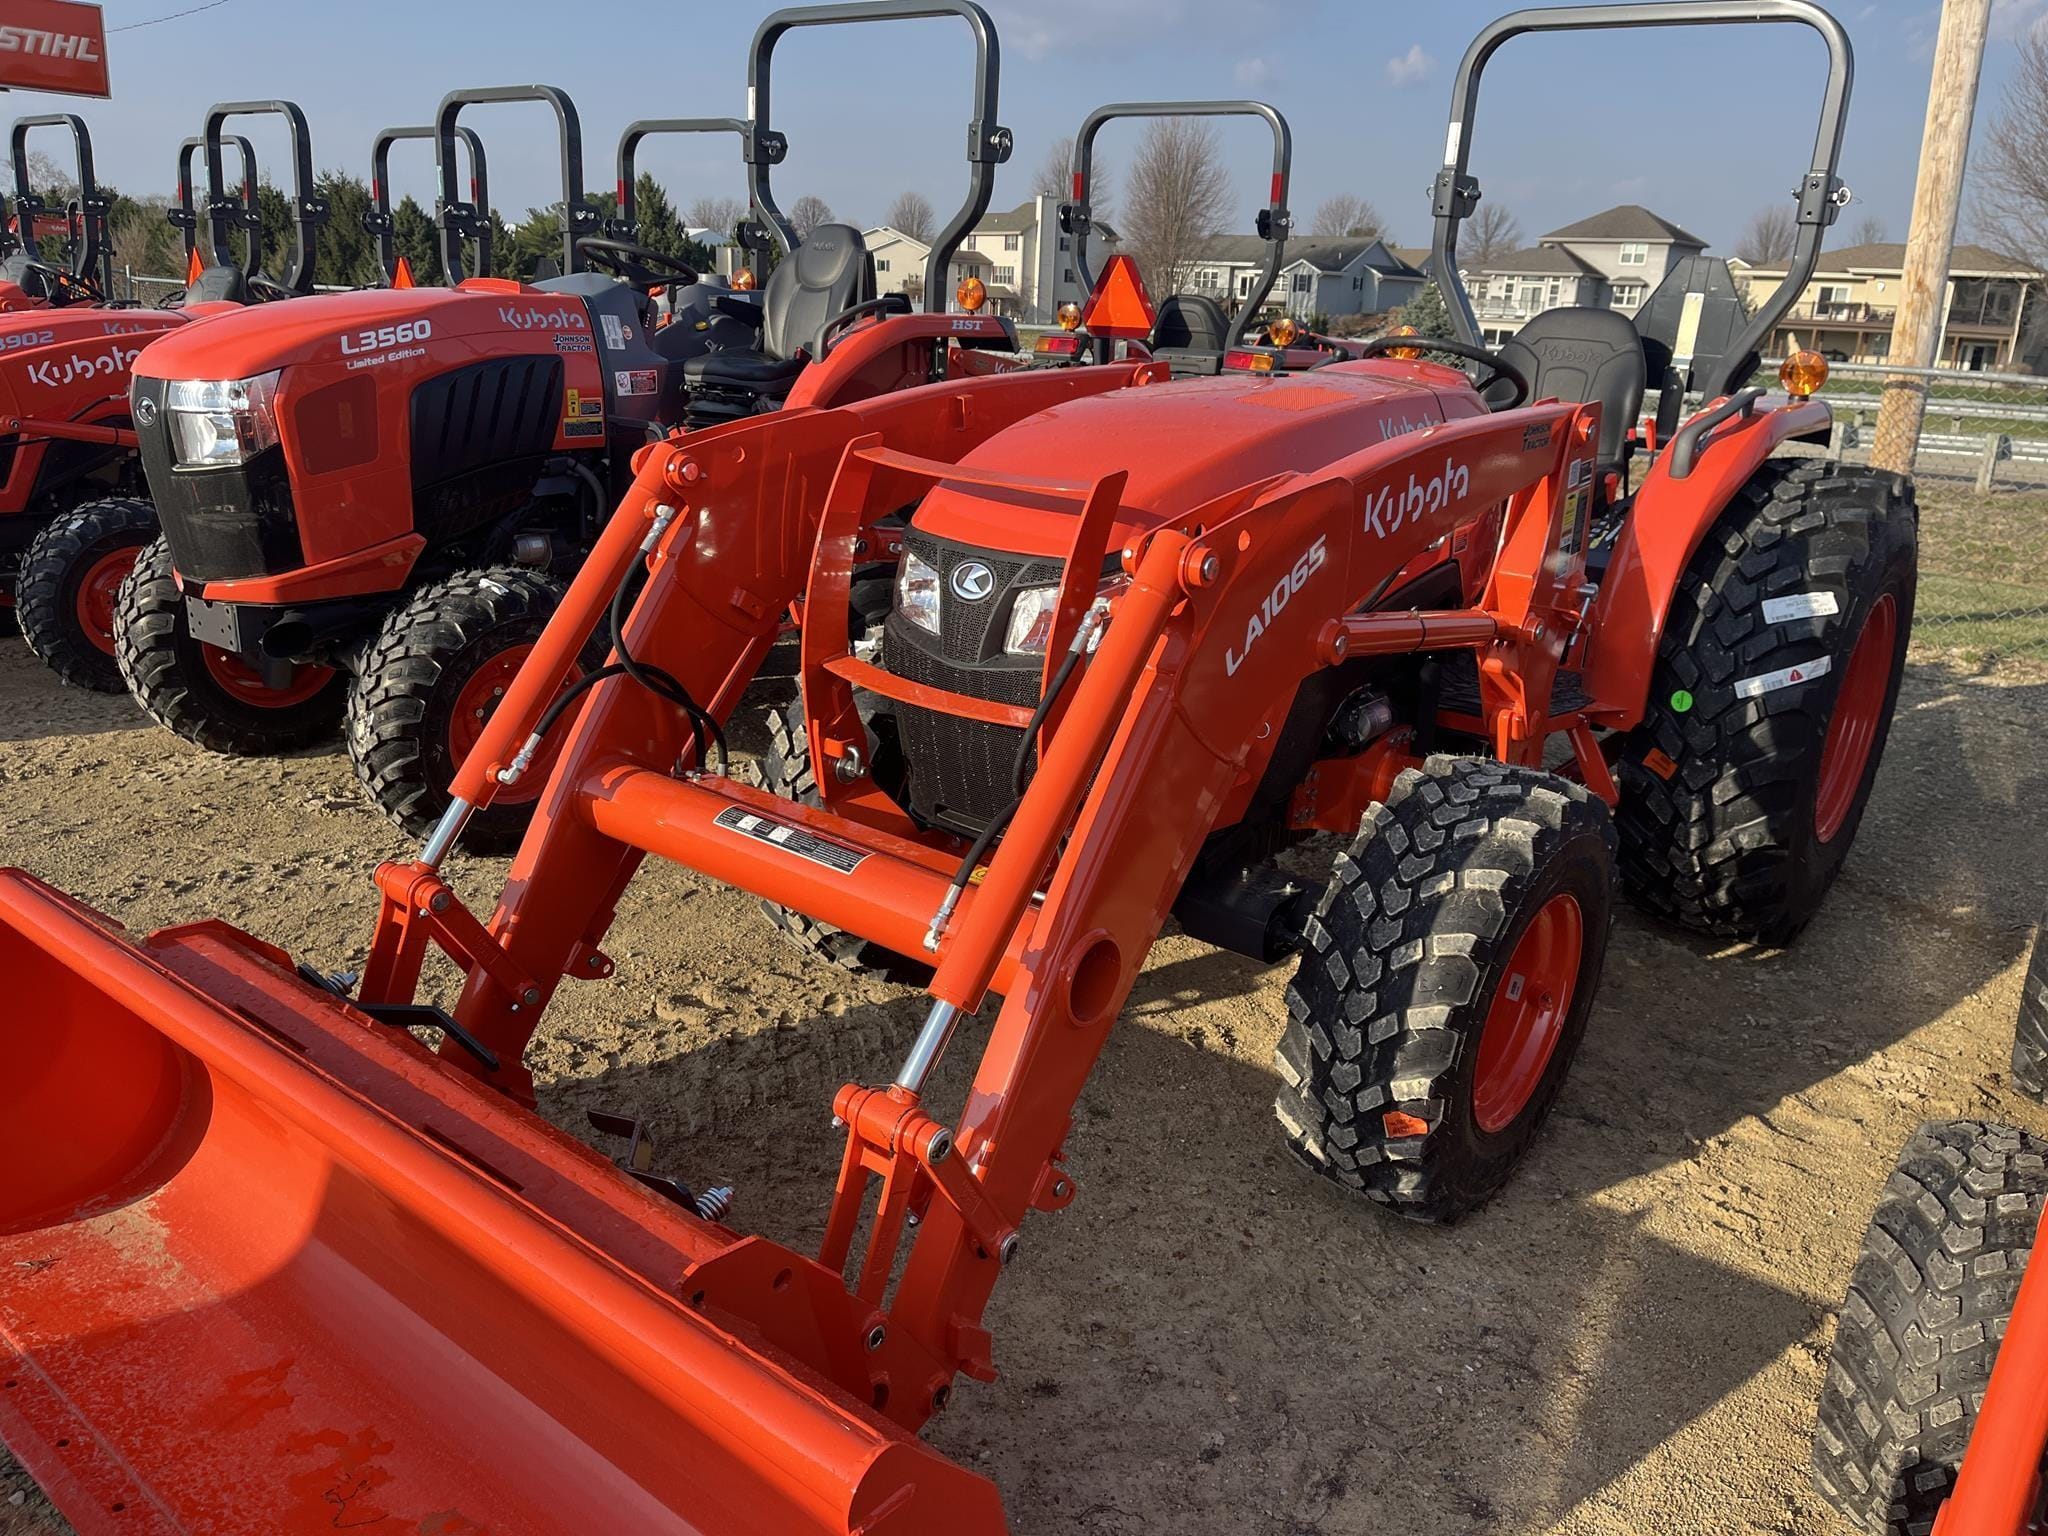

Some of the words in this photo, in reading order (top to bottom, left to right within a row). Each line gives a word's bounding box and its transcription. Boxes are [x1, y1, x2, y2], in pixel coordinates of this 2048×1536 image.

[0, 26, 99, 62] STIHL
[498, 307, 585, 329] Kubota
[952, 320, 984, 331] HST
[341, 319, 432, 355] L3560
[555, 343, 592, 352] TRACTOR
[346, 355, 385, 370] Limited
[388, 348, 425, 362] Edition
[1364, 457, 1469, 539] Kubota
[1225, 534, 1327, 677] LA1065
